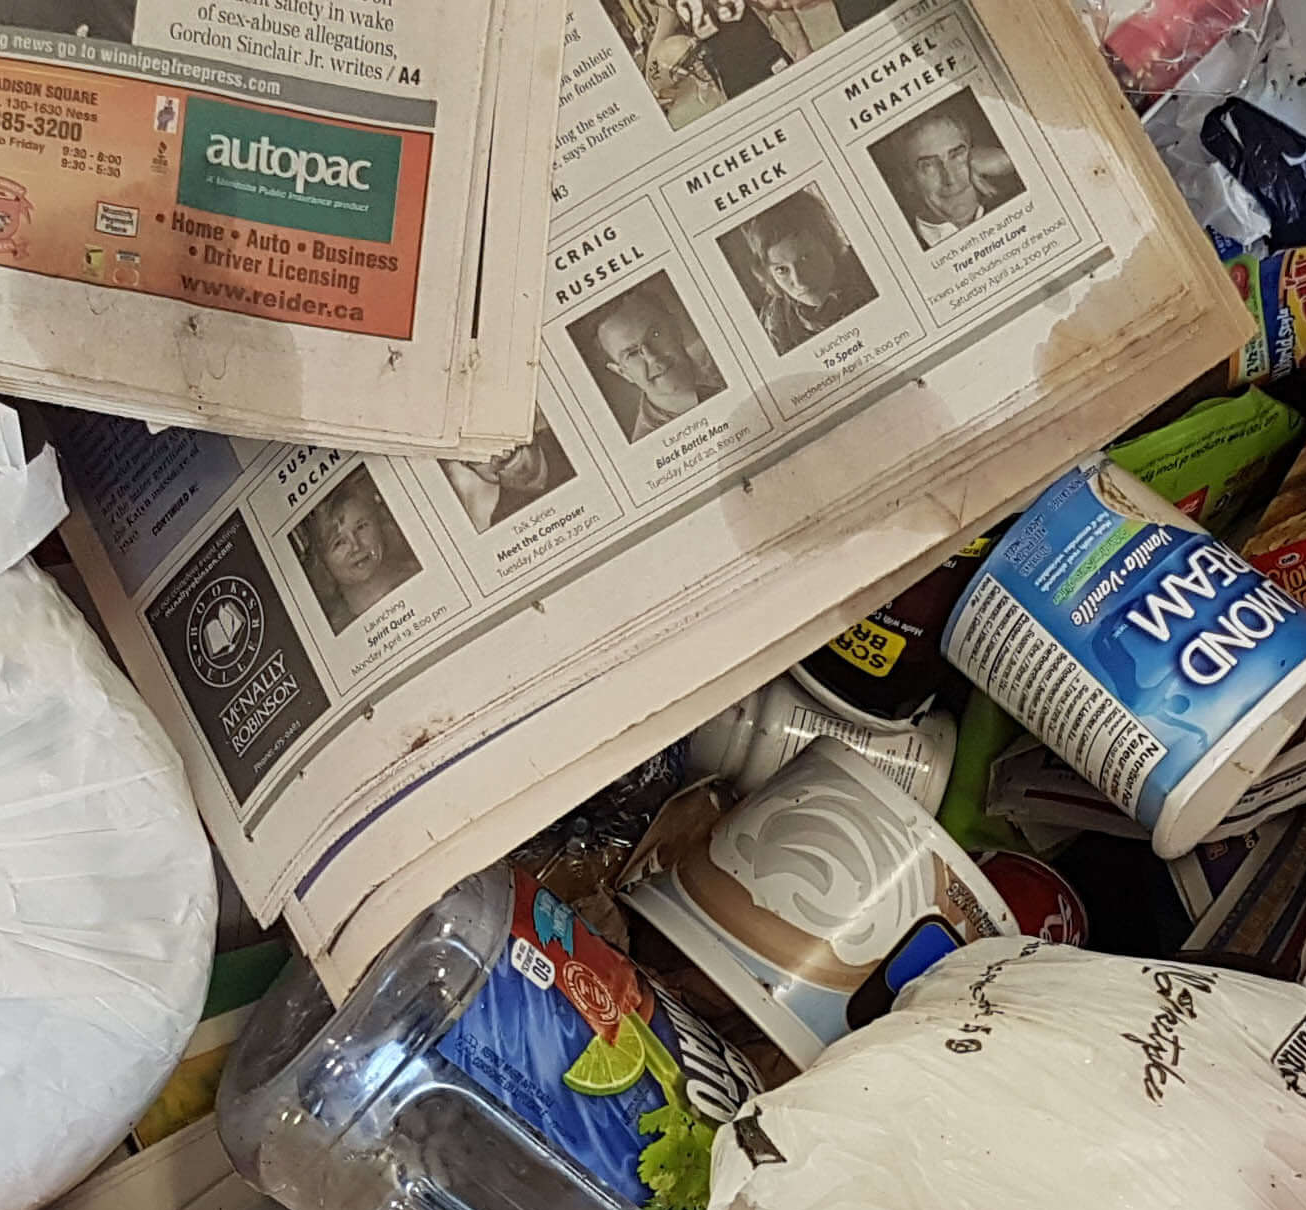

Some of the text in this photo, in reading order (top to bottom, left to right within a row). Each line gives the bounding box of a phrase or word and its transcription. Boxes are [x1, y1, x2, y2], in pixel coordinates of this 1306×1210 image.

[217, 11, 398, 60] sex-abuse allegations,
[350, 9, 395, 32] wake
[13, 37, 53, 53] news
[58, 43, 76, 58] go
[81, 44, 95, 59] to
[100, 46, 281, 96] winnipegfreepress.com
[170, 23, 421, 87] Gordon Sinclair Jr. writes A4
[571, 46, 614, 82] athletic
[843, 36, 938, 101] MICHAEL
[45, 85, 99, 105] SQUARE
[572, 63, 618, 103] football
[848, 55, 958, 130] IGNATIEFF
[66, 106, 98, 122] Ness
[595, 101, 622, 124] seat
[205, 132, 372, 193] autopac
[563, 144, 588, 166] says
[684, 128, 788, 195] MICHELLE
[713, 162, 788, 212] ELRICK
[171, 211, 224, 241] Home
[246, 229, 291, 254] Auto
[312, 240, 400, 272] Business
[555, 226, 618, 271] CRAIG
[952, 224, 1028, 274] True Patriot Love
[204, 244, 360, 295] Driver Licensing
[555, 246, 645, 304] RUSSELL
[179, 275, 365, 322] www.reider.ca
[836, 340, 864, 365] Speak
[655, 421, 730, 469] Black Man
[286, 449, 342, 507] ROCAN
[496, 505, 586, 562] Meet the Composer
[367, 609, 416, 648] Spirit Quest
[230, 674, 299, 754] ROBINSON
